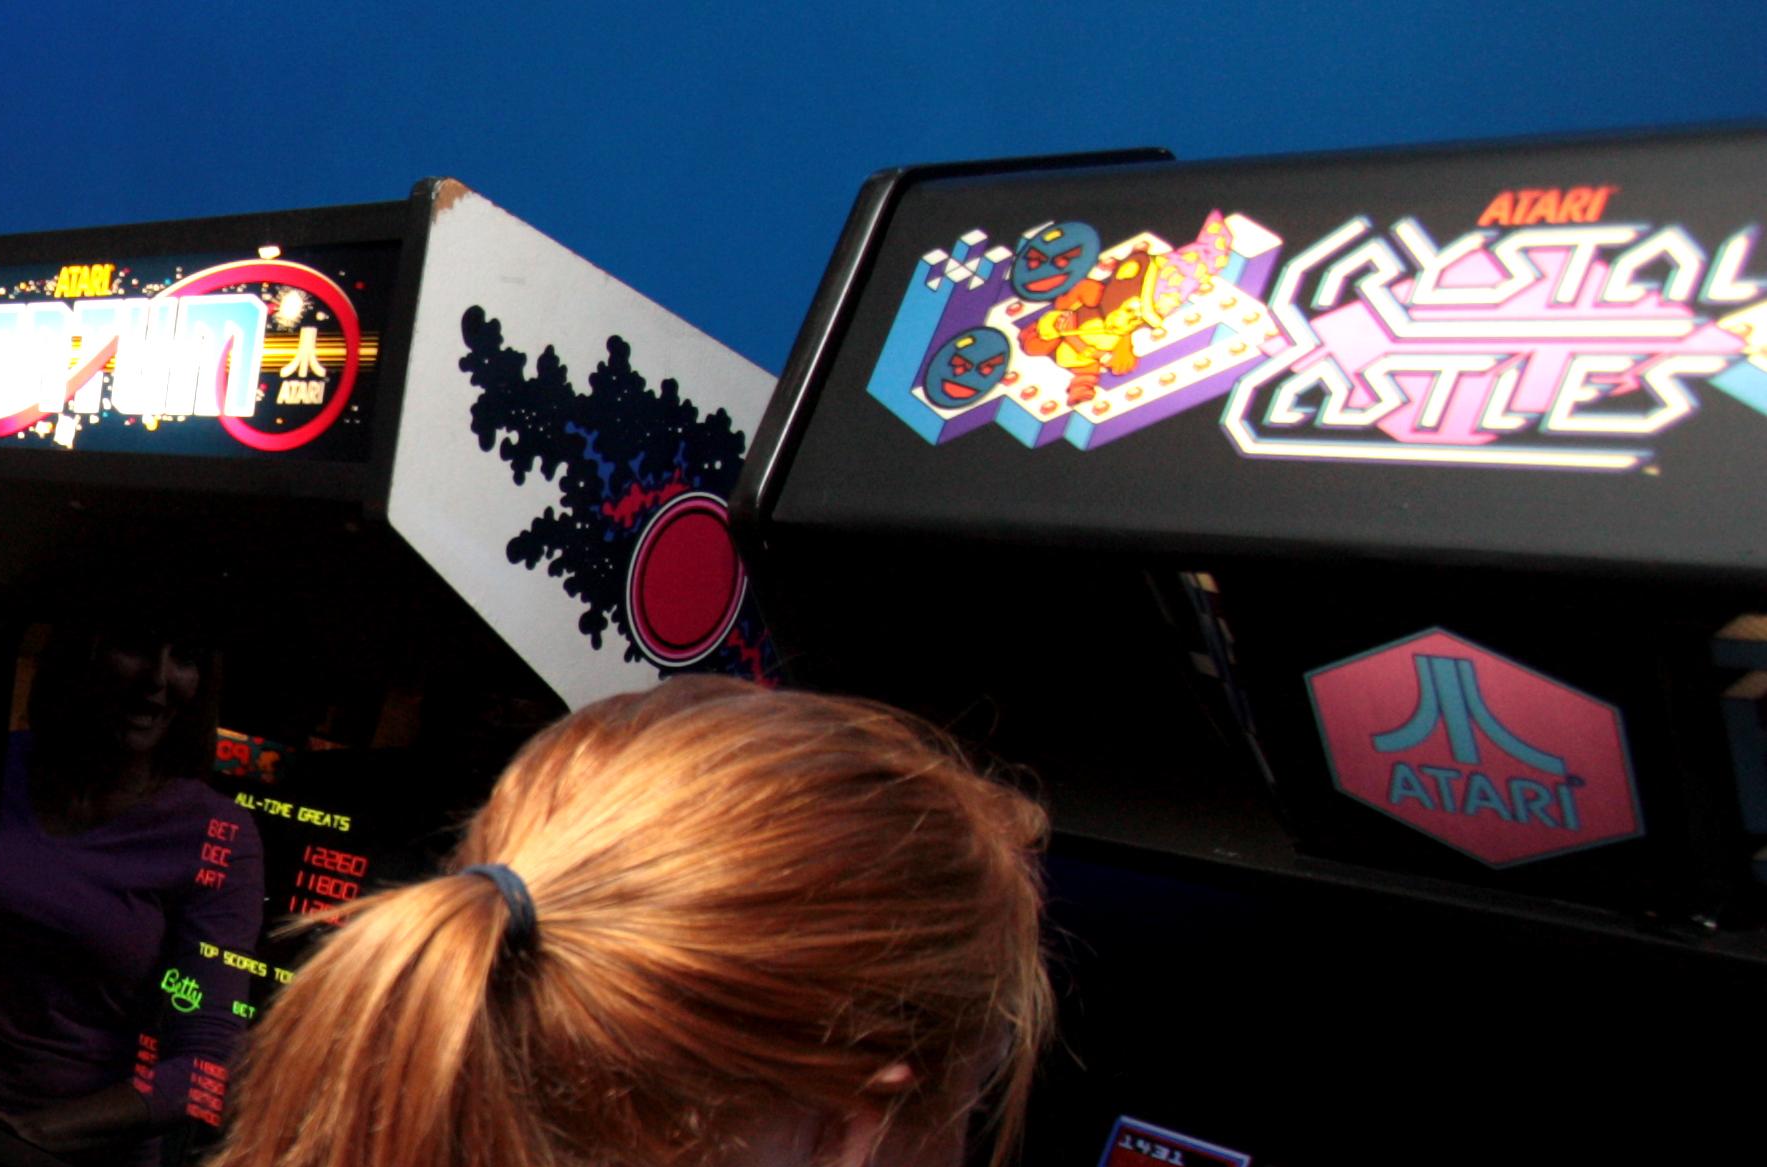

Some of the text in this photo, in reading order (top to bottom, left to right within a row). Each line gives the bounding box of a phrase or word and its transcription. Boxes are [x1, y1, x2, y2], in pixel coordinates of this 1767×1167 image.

[1477, 186, 1609, 226] ATARI
[54, 264, 114, 298] ATARI
[1268, 216, 1767, 338] CRYSTAL
[276, 379, 325, 404] ATARI
[1220, 346, 1729, 470] CASTLES
[234, 792, 353, 832] ALL-TIME GREATS
[1387, 761, 1582, 832] ATARI
[206, 818, 370, 879] BET 12260
[194, 867, 227, 890] ART
[200, 842, 360, 901] DEC 11800
[198, 941, 220, 959] TOP
[223, 950, 268, 978] SCORES
[160, 968, 203, 1013] Betty
[1117, 1133, 1187, 1167] 1431
